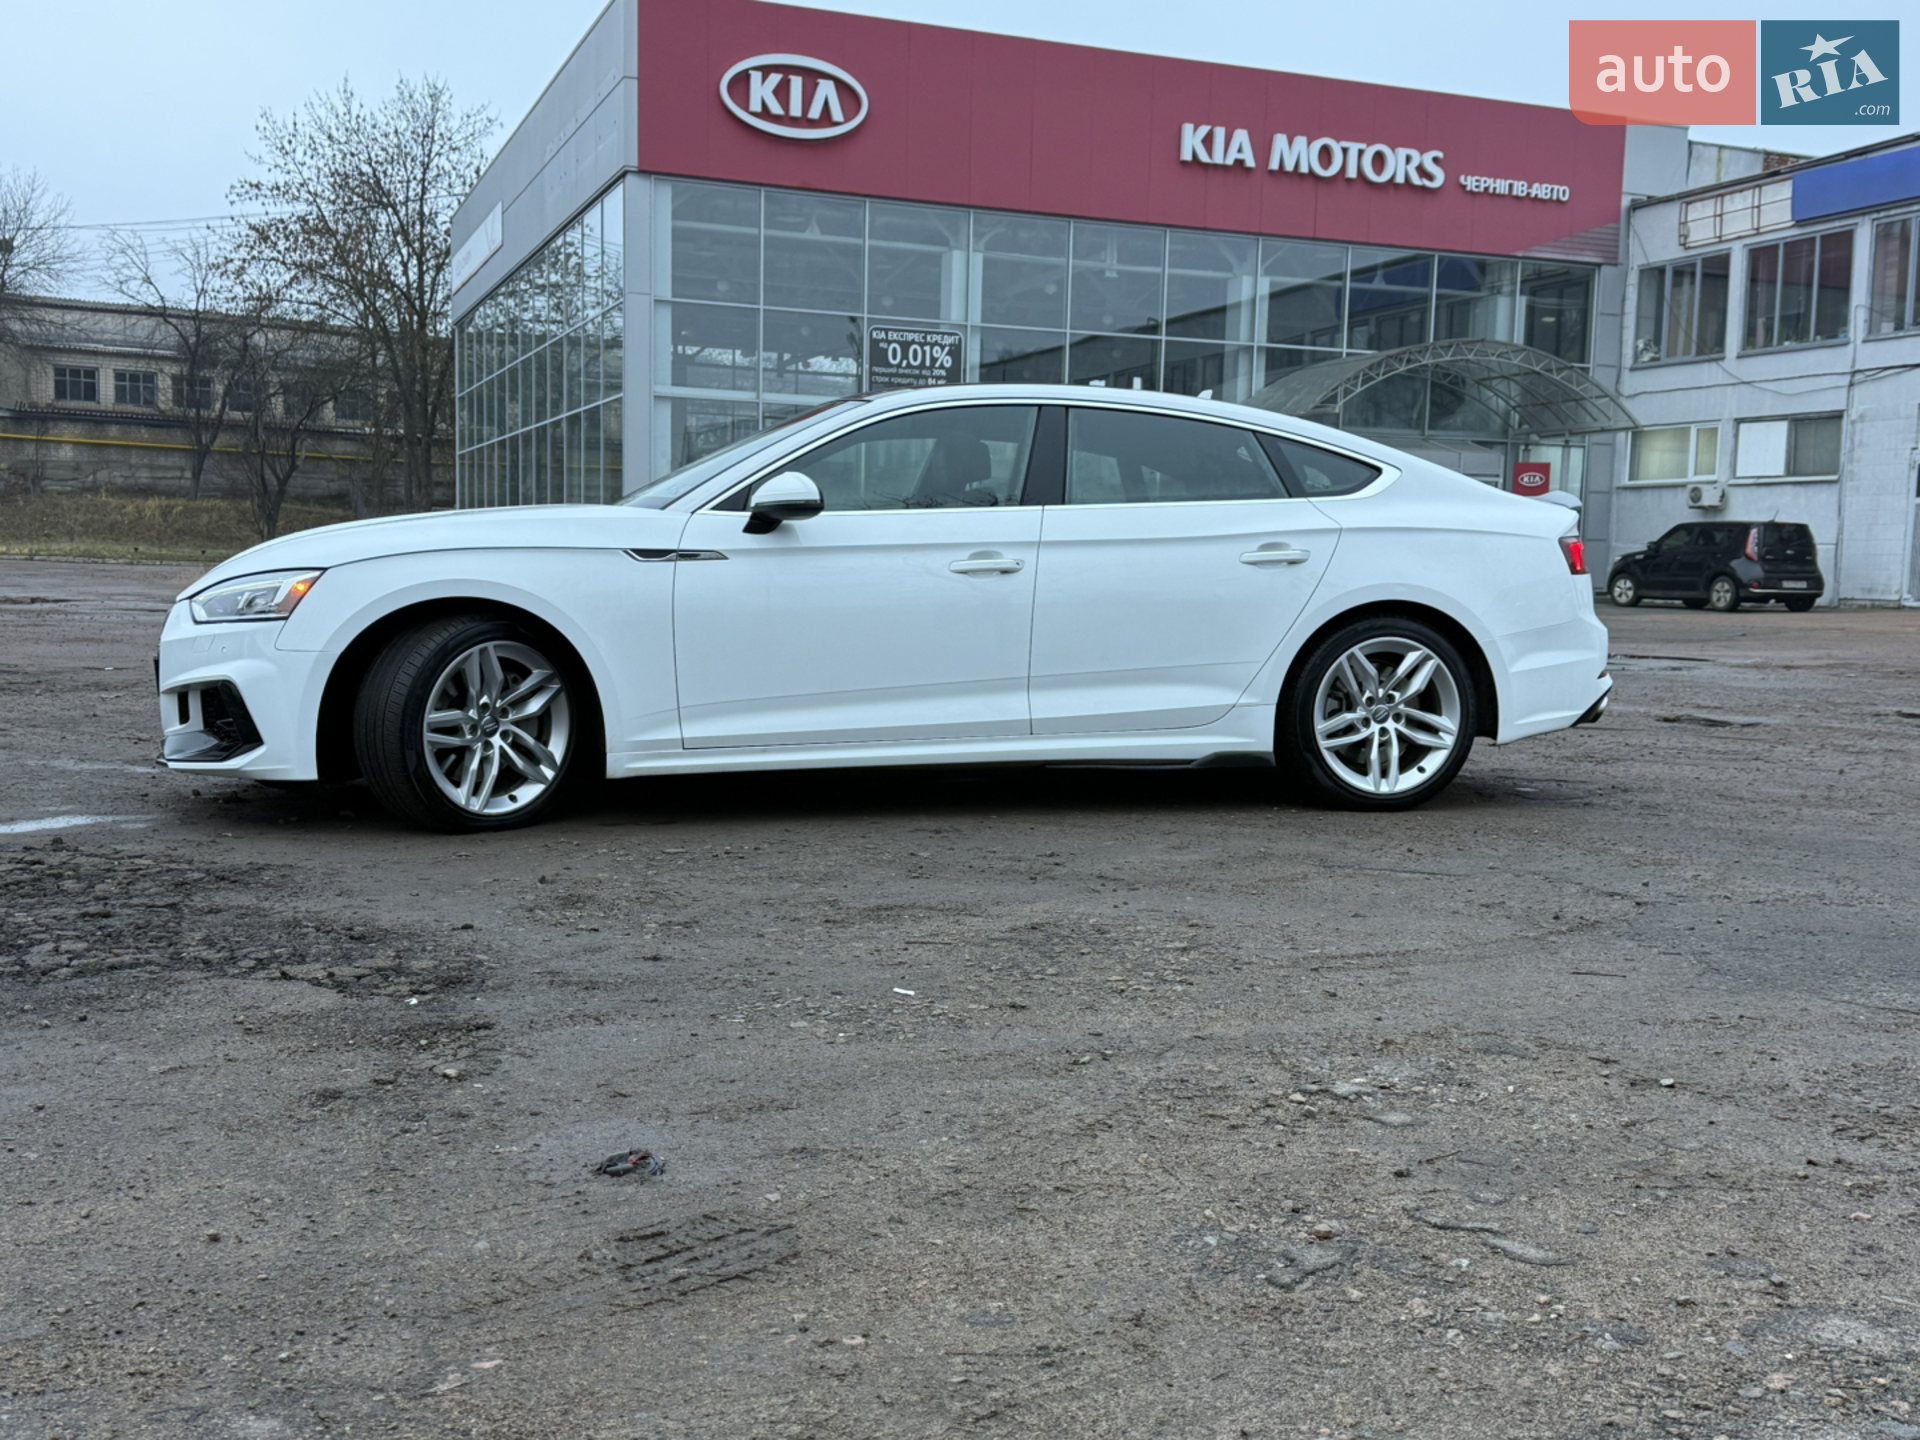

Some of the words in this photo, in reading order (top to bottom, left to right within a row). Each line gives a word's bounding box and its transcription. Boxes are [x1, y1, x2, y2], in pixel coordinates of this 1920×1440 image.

[747, 69, 846, 123] KIA
[1178, 122, 1256, 168] KIA
[1267, 132, 1446, 189] MOTORS
[1458, 173, 1570, 203] ЧЕРНІГІВ-АВТО
[888, 331, 925, 342] ЕКСПРЕС
[926, 334, 960, 345] КРЕДИТ
[932, 368, 946, 376] 20%
